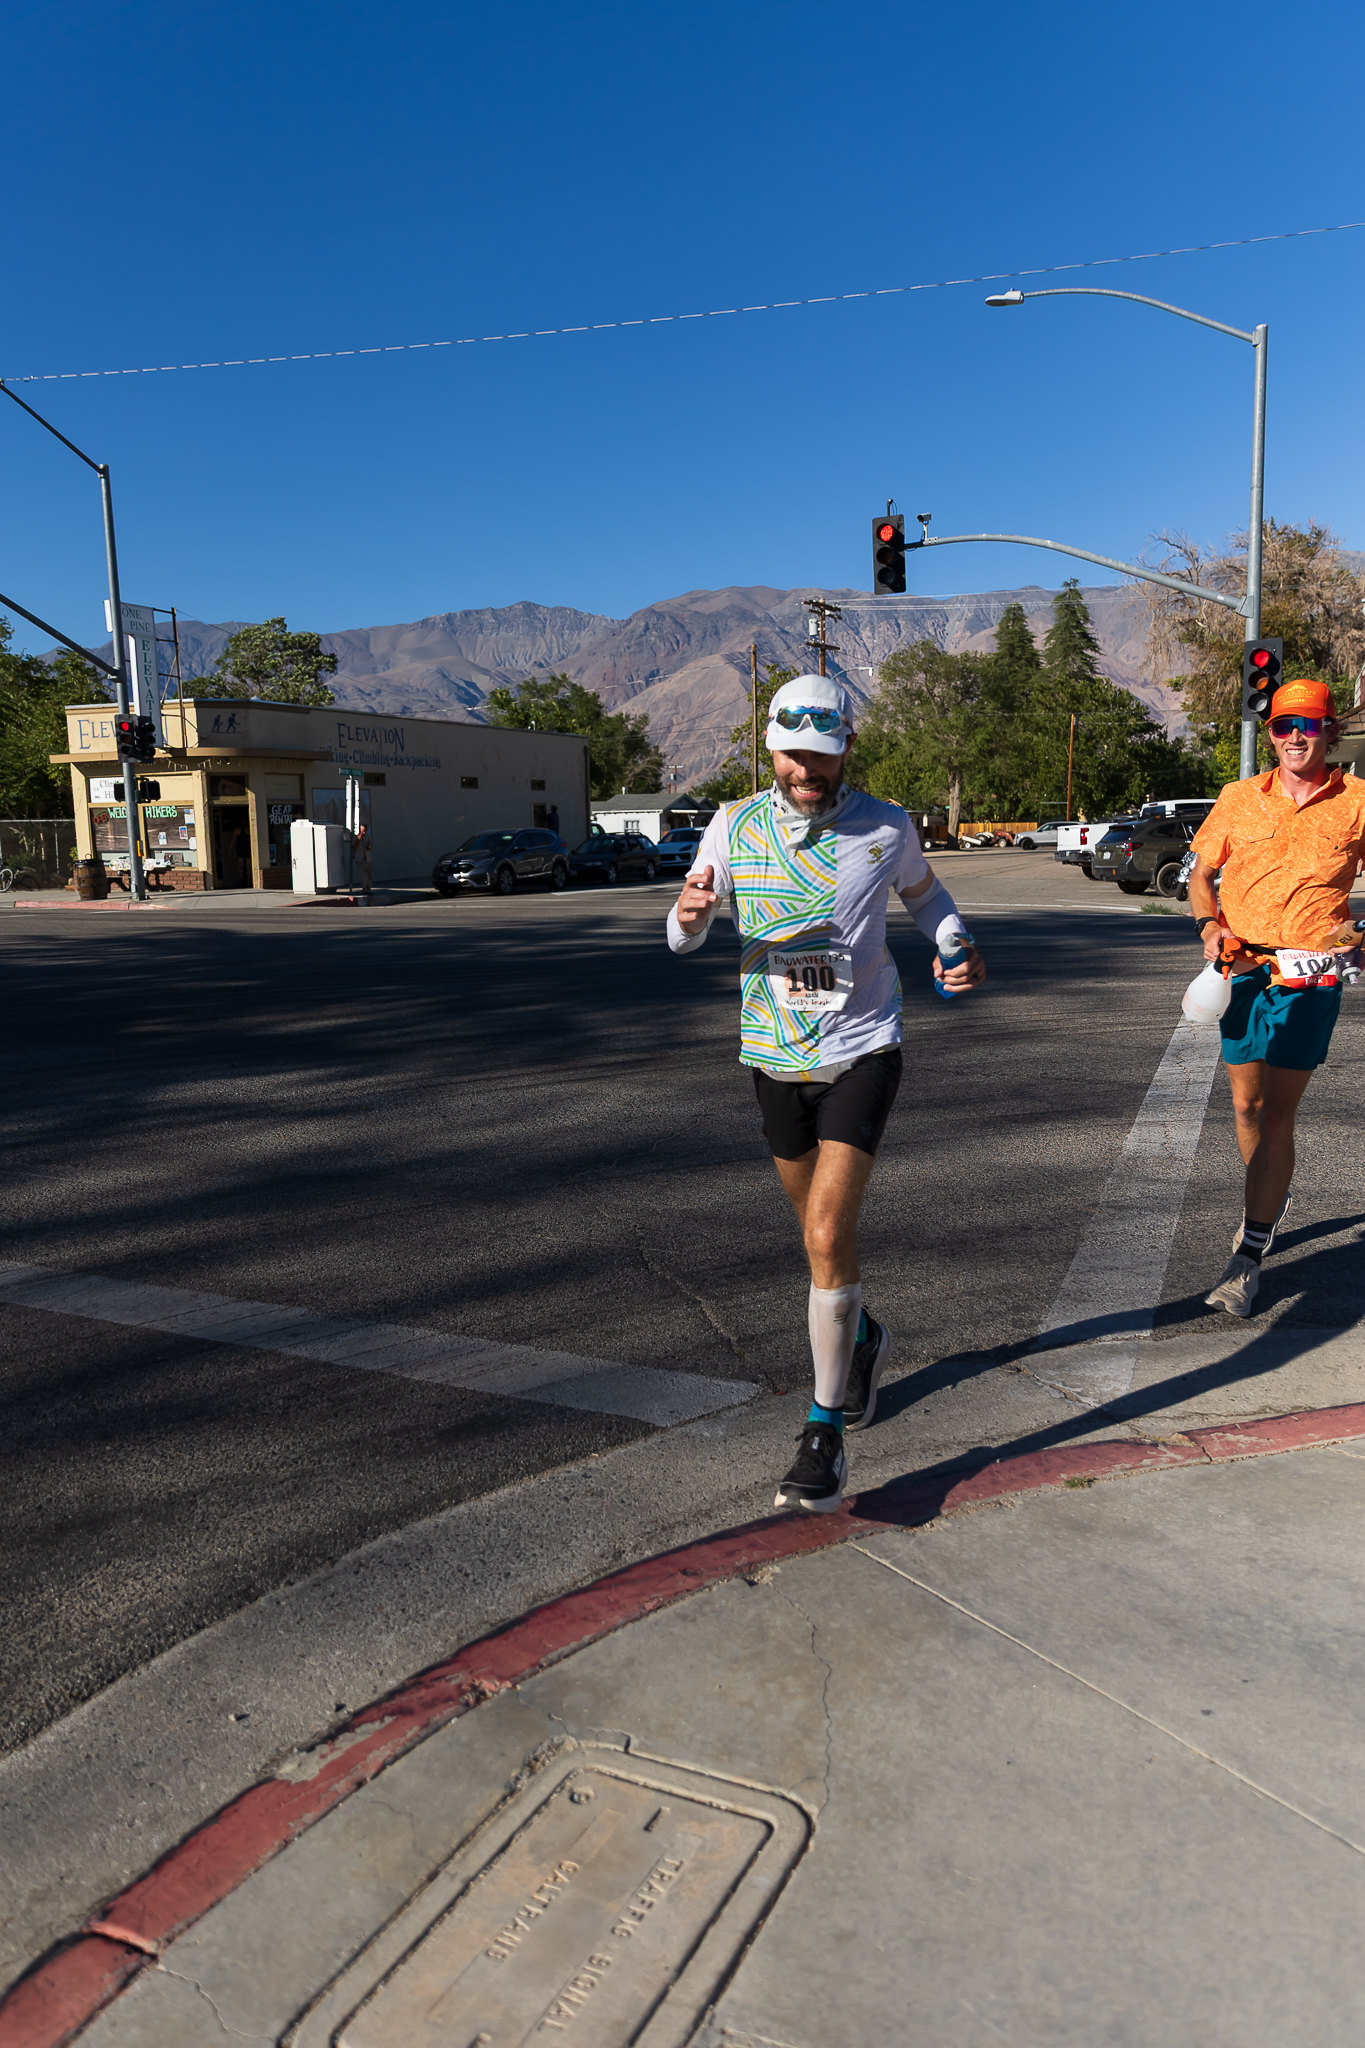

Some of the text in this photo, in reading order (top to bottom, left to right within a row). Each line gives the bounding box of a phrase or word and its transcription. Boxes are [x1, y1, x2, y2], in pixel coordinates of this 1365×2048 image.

[122, 607, 141, 620] ONE
[130, 621, 151, 632] PINE
[337, 723, 405, 752] ELEVATION
[353, 749, 391, 767] Climbing
[394, 752, 441, 769] Backpacking
[145, 806, 178, 818] HIKERS
[774, 953, 845, 966] BADWATER 135
[787, 966, 835, 992] 100
[486, 1860, 579, 1961] CALTRANS
[537, 1856, 684, 2032] TRAFFIC SIGNAL
